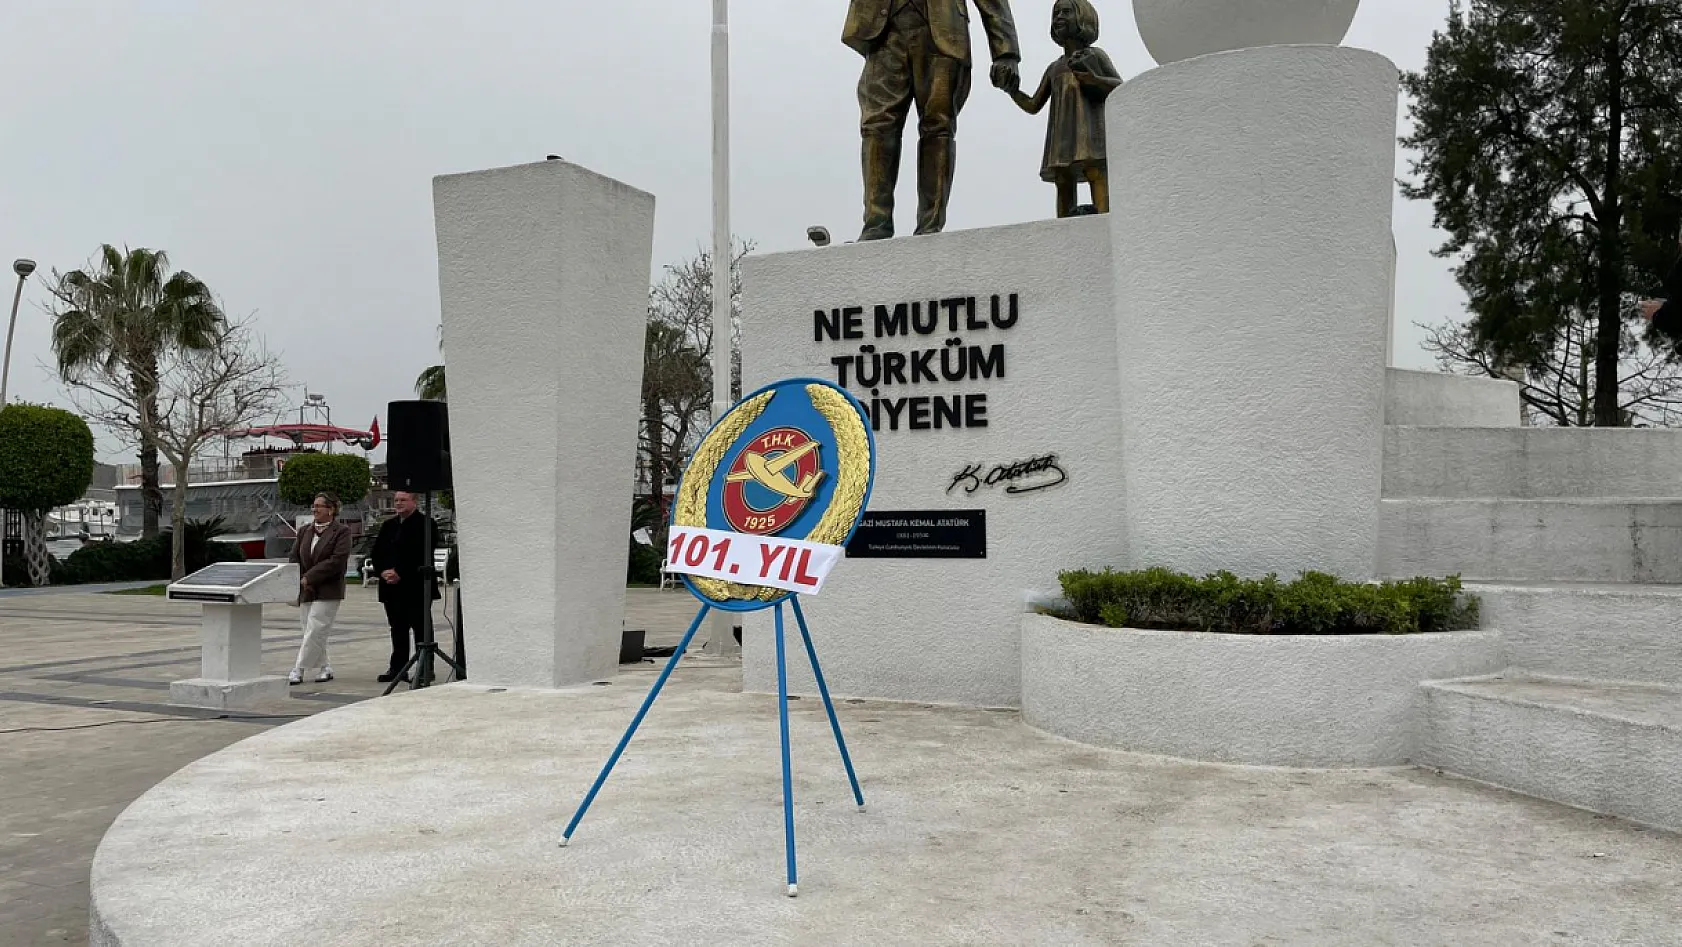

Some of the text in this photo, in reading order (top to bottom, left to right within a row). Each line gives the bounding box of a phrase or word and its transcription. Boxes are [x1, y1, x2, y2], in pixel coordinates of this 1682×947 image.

[814, 293, 1018, 341] NE MUTLU
[831, 337, 1005, 388] TÜRKÜM
[859, 388, 988, 431] İYENE
[744, 515, 776, 529] 1925
[875, 519, 909, 527] MUSTAFA
[909, 519, 935, 527] KEMAL
[936, 517, 970, 527] ATATÜRK
[670, 532, 819, 586] 101. YIL
